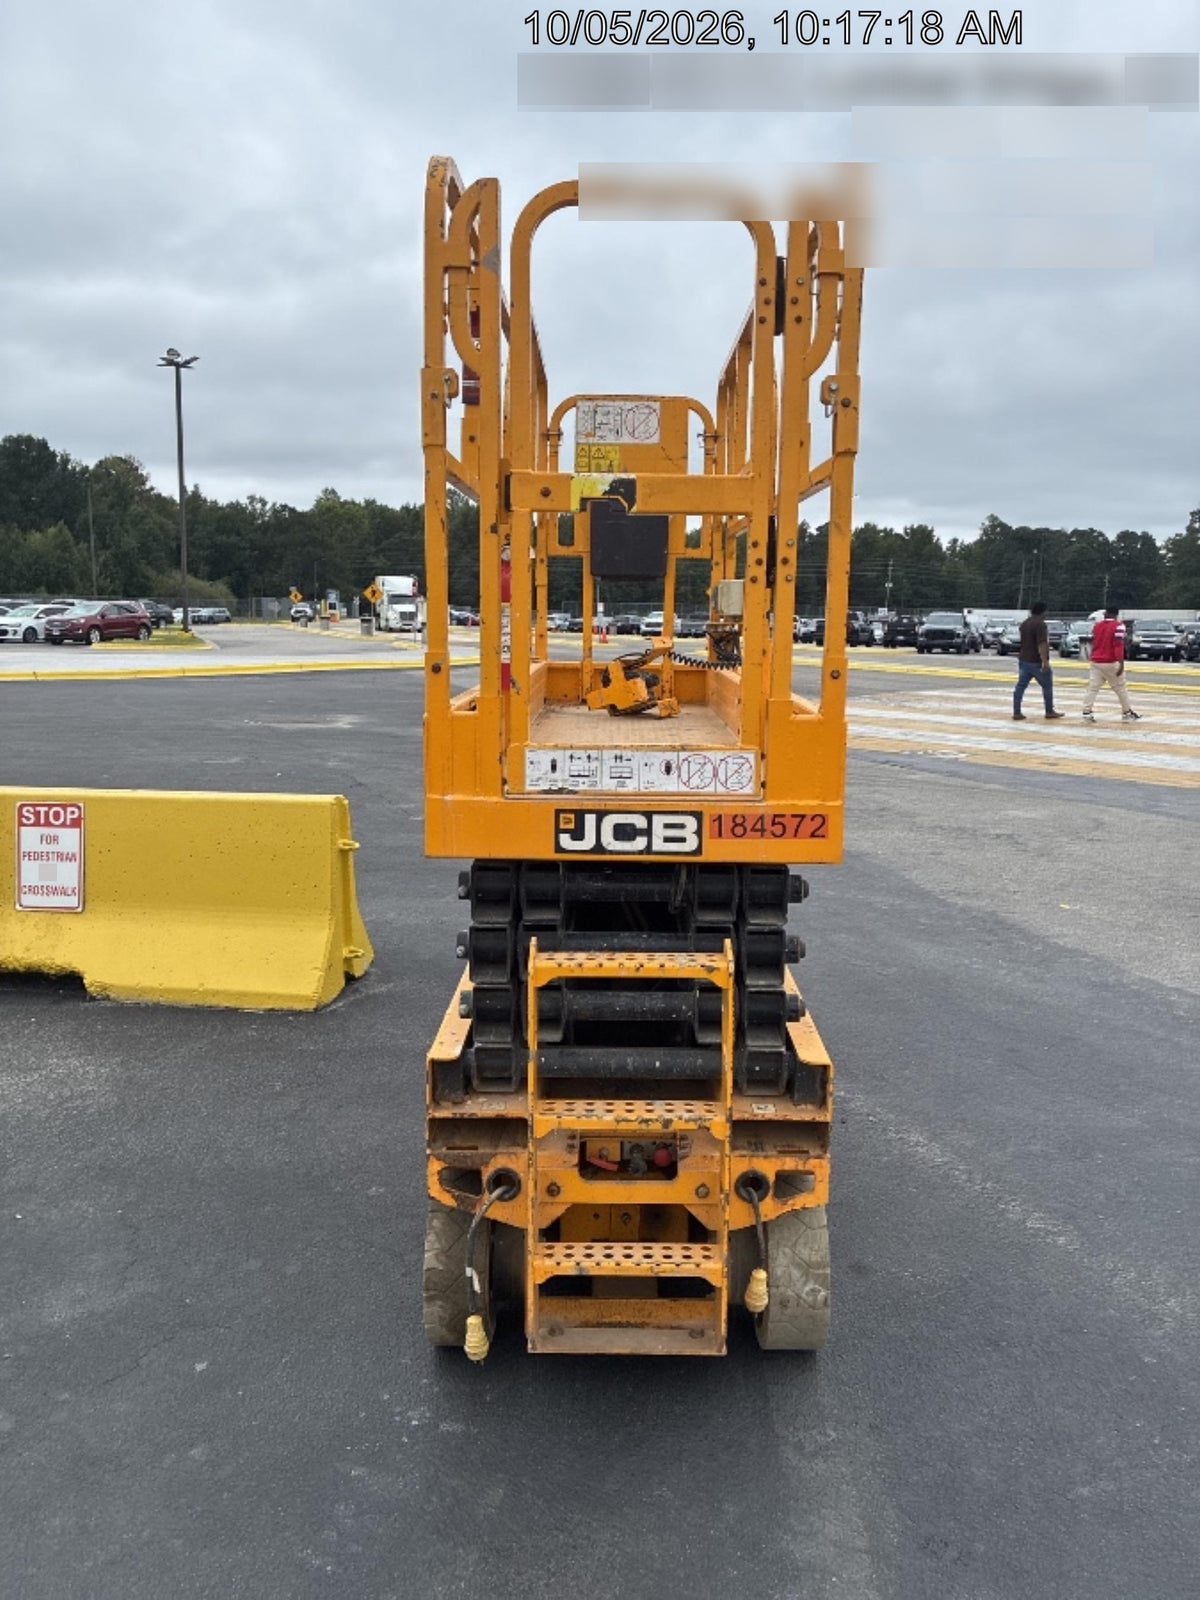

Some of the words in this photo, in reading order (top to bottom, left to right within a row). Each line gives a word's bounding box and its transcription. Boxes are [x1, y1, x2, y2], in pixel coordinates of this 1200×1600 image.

[21, 806, 79, 826] STOP
[558, 813, 699, 853] JCB
[712, 813, 826, 839] 184572
[40, 834, 60, 845] FOR
[22, 851, 77, 863] PEDESTRIAN
[22, 885, 77, 897] CROSSWALK
